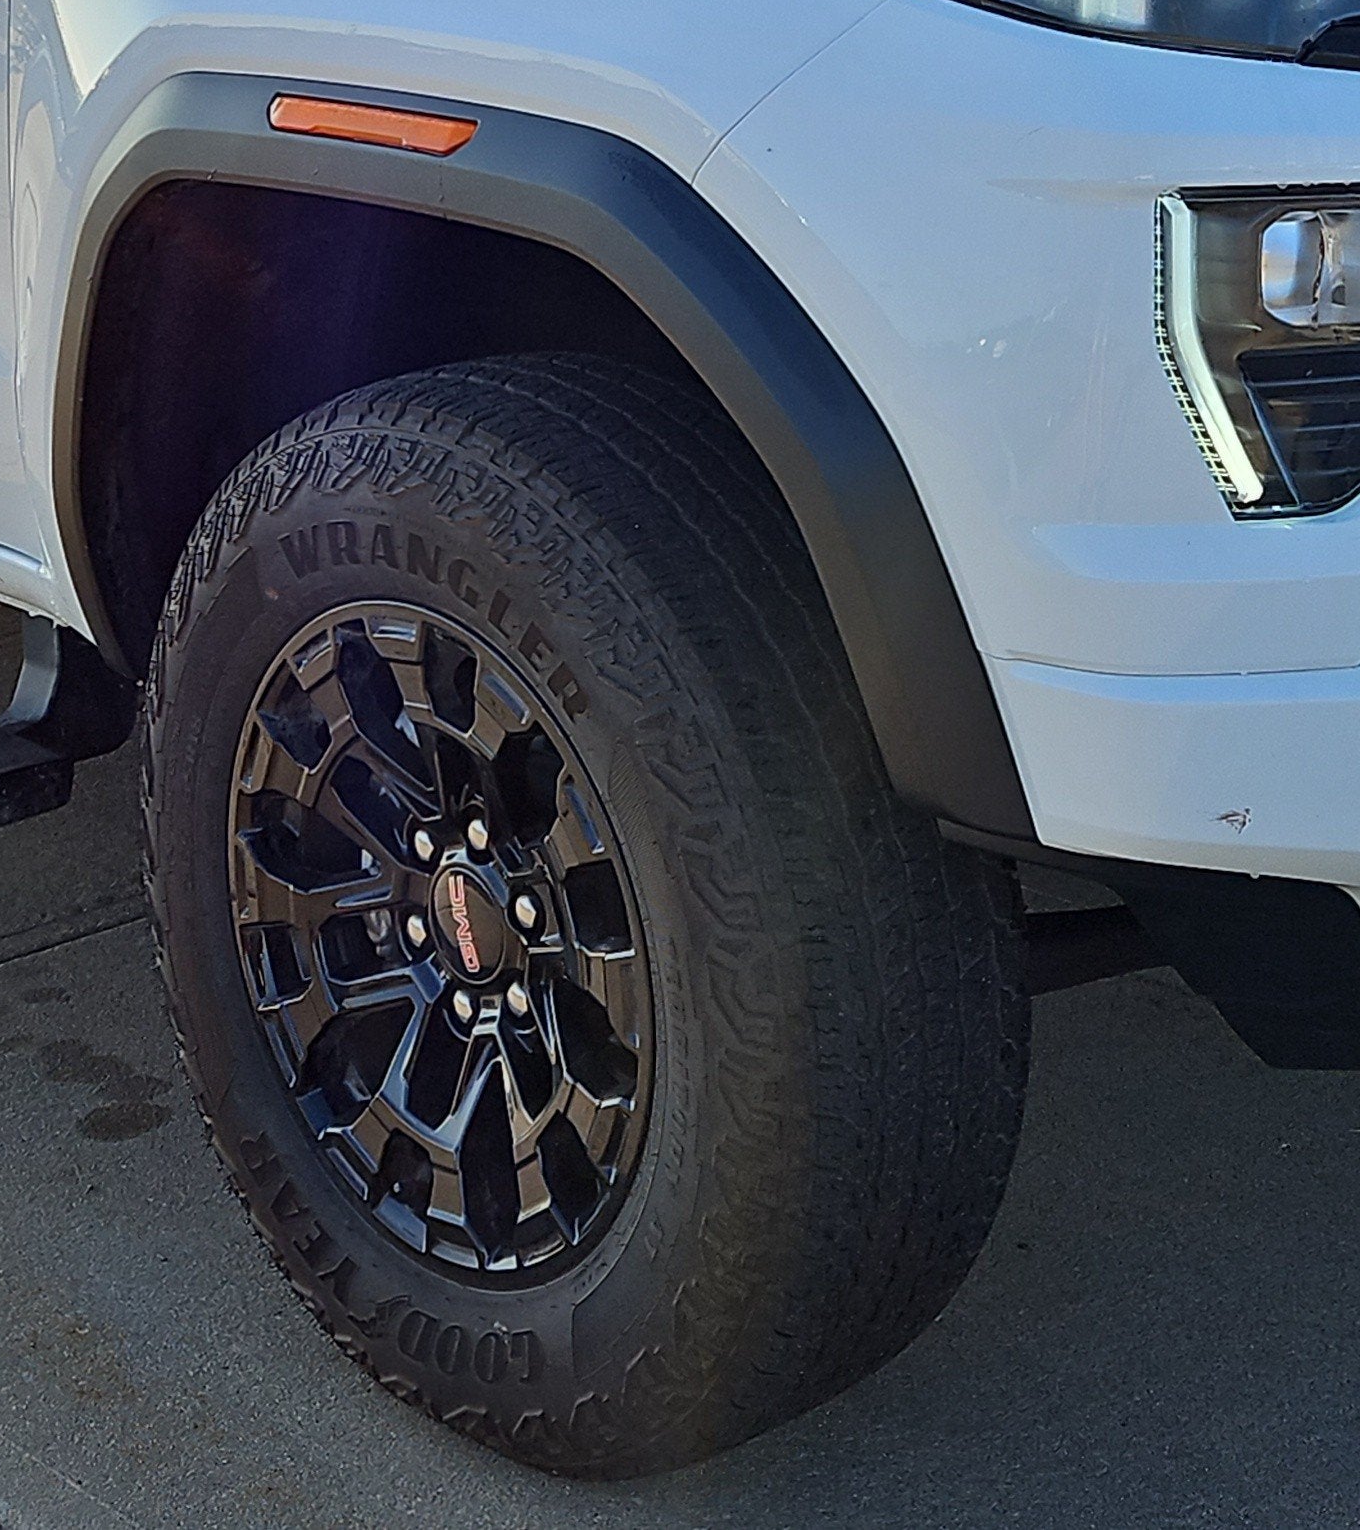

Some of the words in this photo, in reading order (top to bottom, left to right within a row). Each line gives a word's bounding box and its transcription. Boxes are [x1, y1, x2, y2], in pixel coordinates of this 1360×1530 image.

[276, 519, 590, 726] WRANGLER
[447, 873, 482, 974] GMC
[238, 1129, 540, 1384] GOODYEAR
